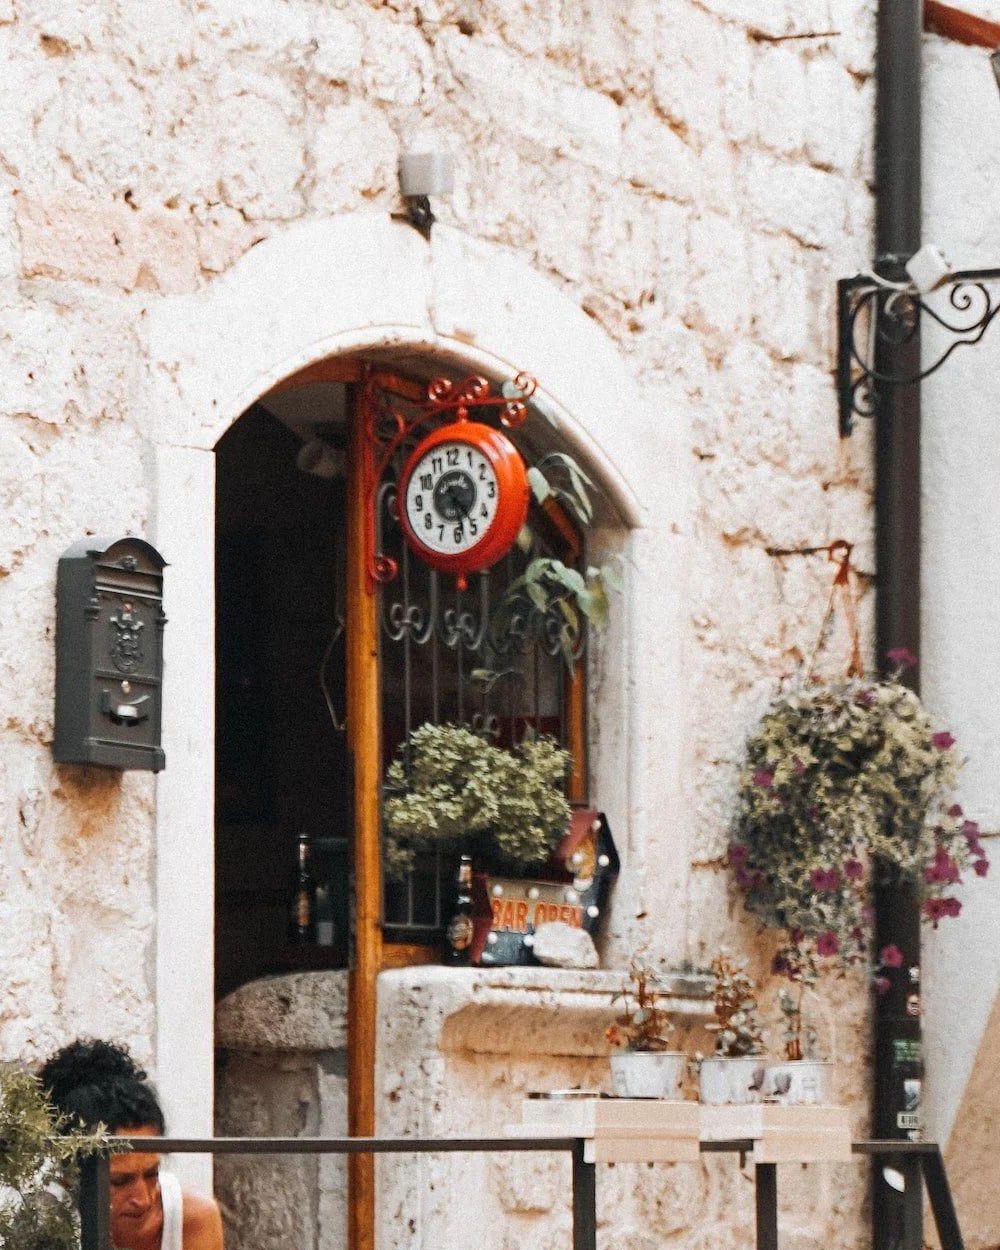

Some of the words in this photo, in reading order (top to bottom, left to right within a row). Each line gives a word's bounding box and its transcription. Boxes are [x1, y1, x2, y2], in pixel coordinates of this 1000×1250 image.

[432, 457, 442, 474] 11
[446, 448, 459, 467] 12
[467, 451, 473, 468] 1
[479, 463, 486, 480] 2
[420, 473, 434, 492] 10
[487, 481, 495, 498] 3
[415, 494, 423, 512] 9
[424, 512, 433, 530] 8
[469, 518, 477, 536] 5
[437, 523, 445, 541] 7
[490, 897, 529, 934] BAR
